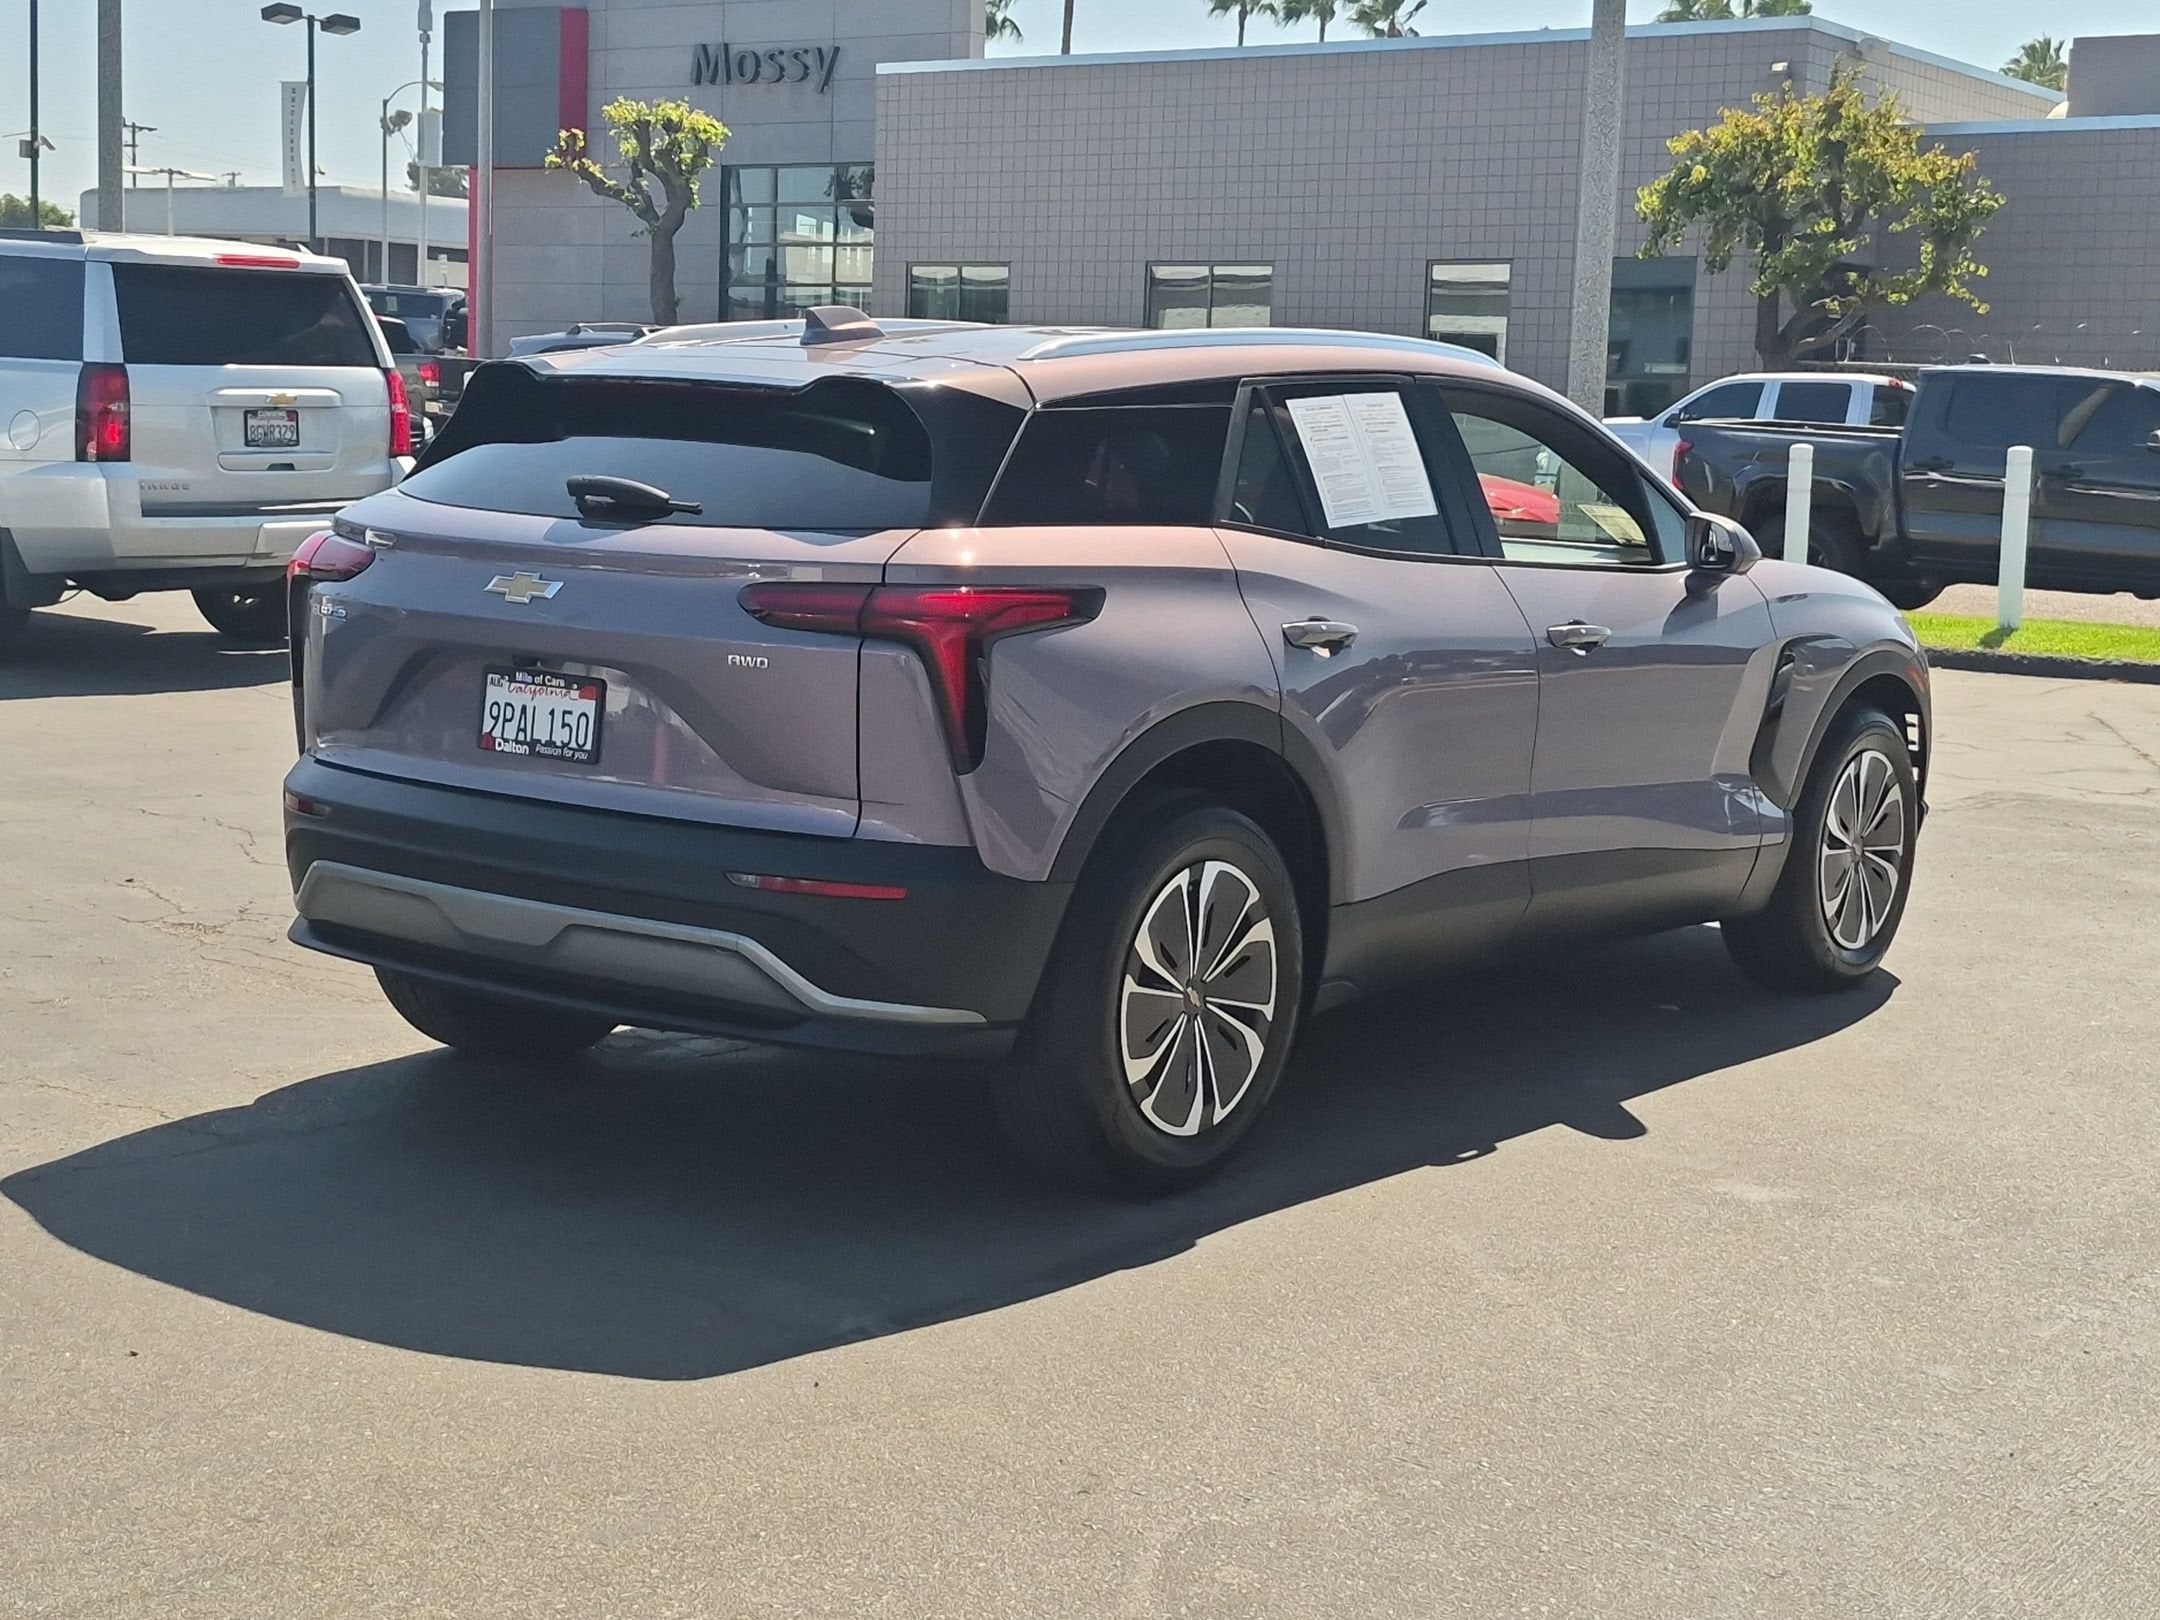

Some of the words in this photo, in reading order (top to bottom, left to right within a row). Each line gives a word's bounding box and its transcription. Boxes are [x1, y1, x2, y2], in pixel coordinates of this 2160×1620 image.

[690, 42, 840, 94] Mossy
[727, 654, 768, 668] AWD
[534, 675, 543, 684] of
[545, 675, 565, 687] Cars
[495, 738, 530, 755] Dalton
[535, 744, 562, 756] Passion
[562, 747, 573, 757] for
[573, 750, 589, 760] you
